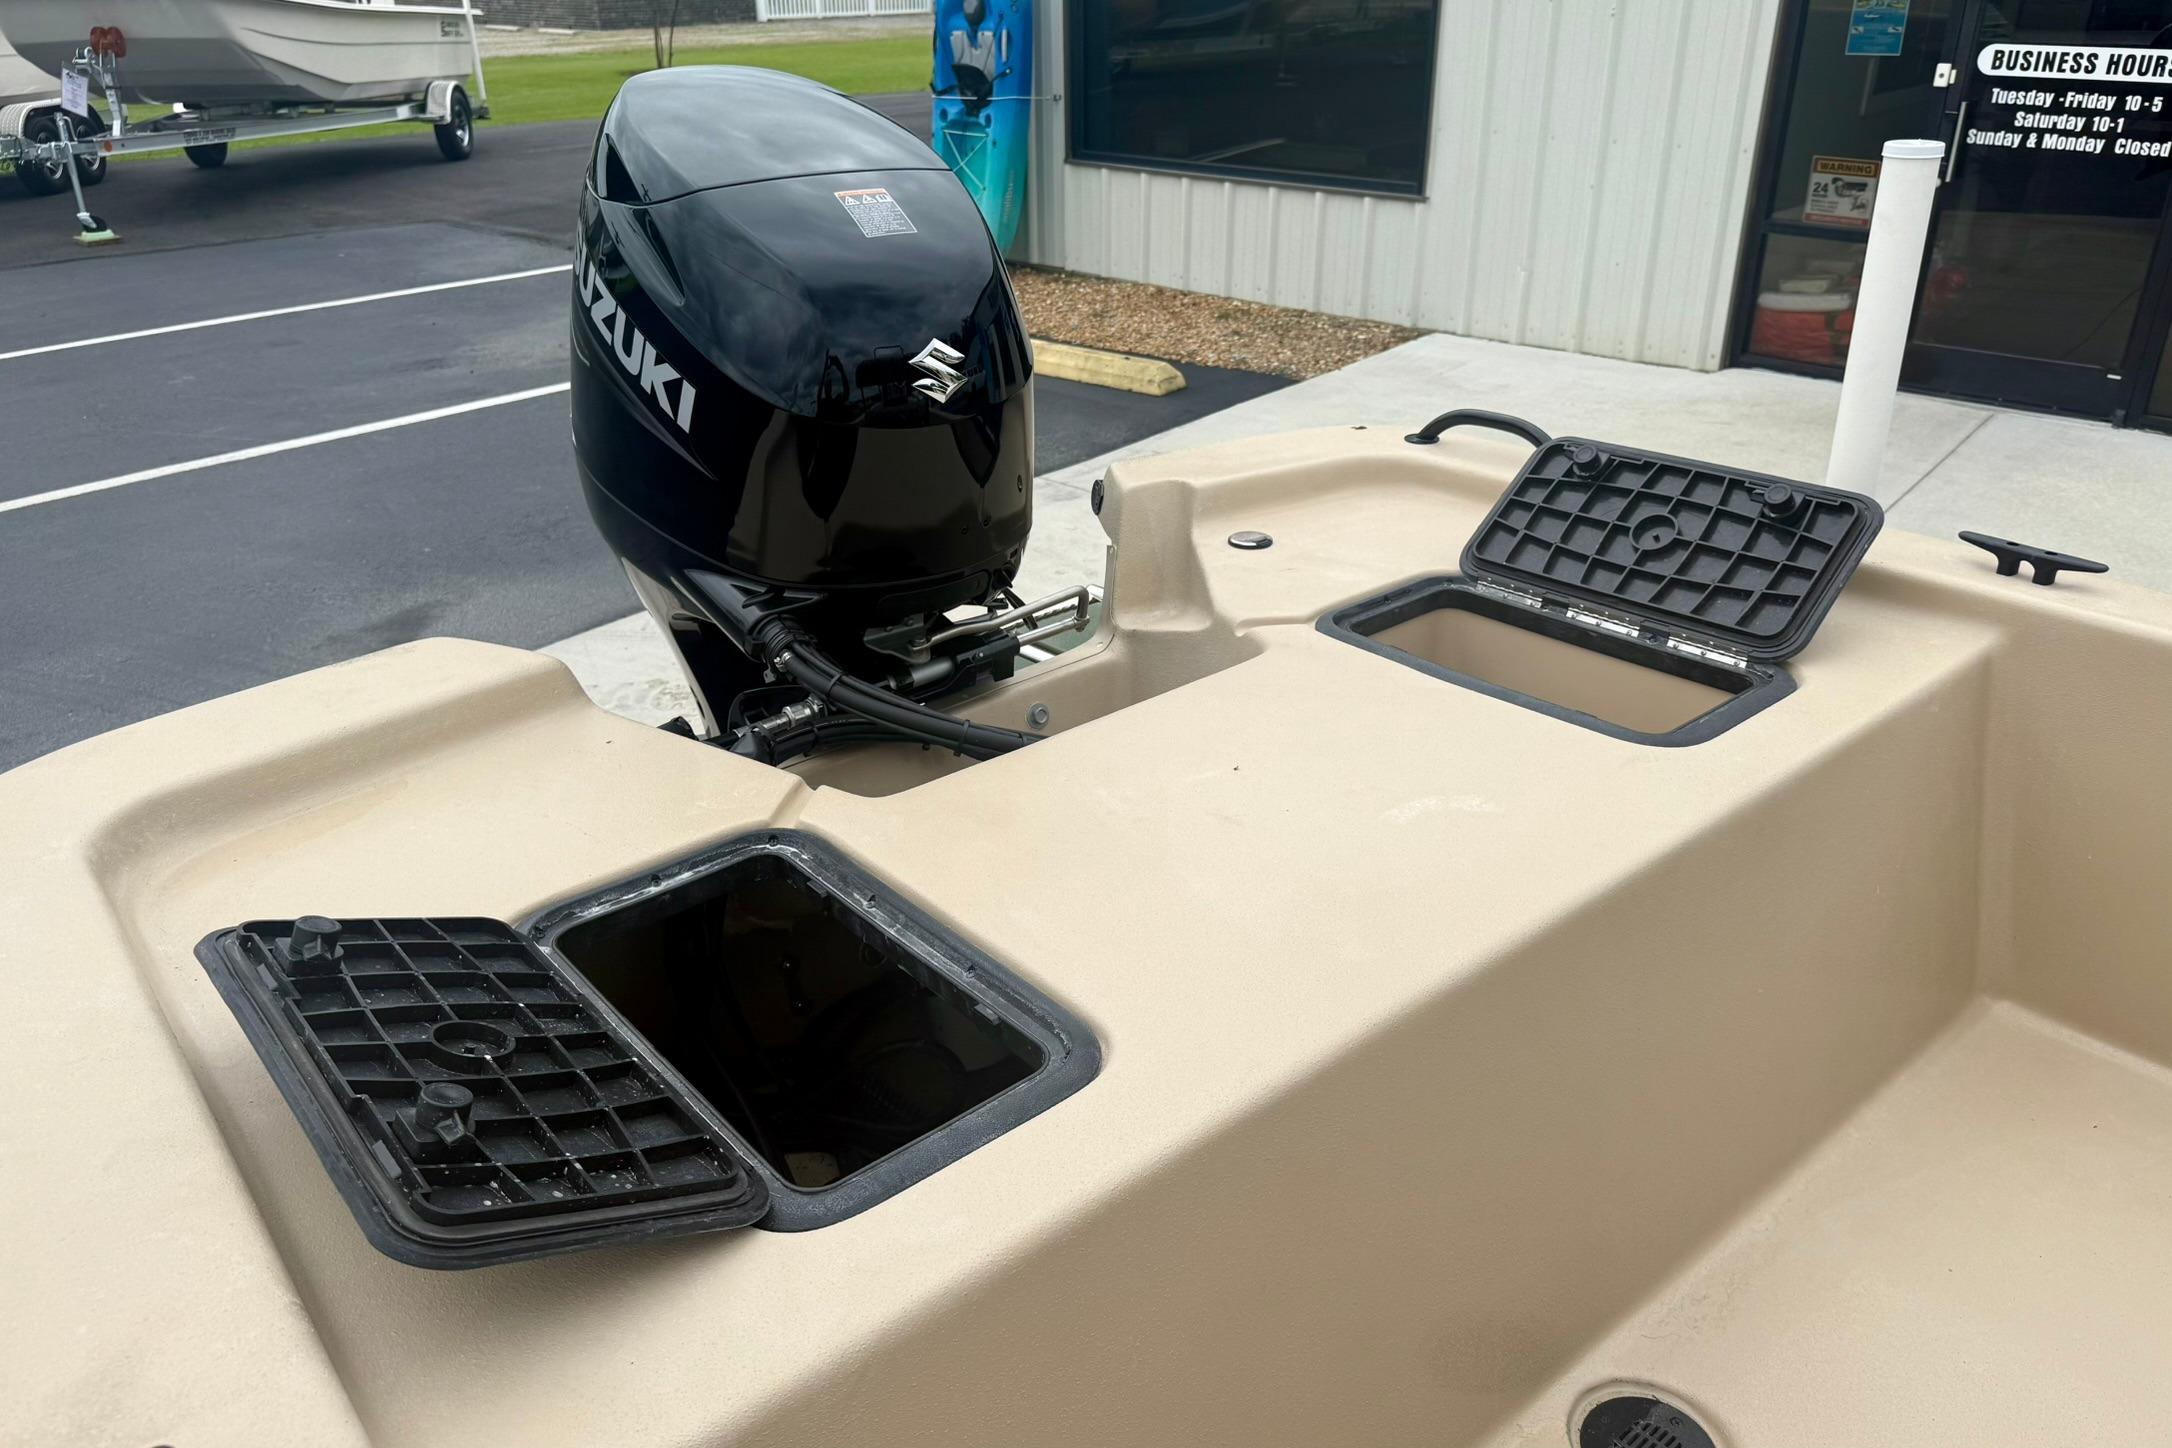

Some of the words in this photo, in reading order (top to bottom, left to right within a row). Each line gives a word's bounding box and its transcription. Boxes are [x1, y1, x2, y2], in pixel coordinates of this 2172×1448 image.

[1991, 49, 2099, 74] BUSINESS
[1991, 88, 2055, 108] Tuesday
[2014, 111, 2086, 132] Saturday
[2092, 116, 2125, 133] 10-1
[1966, 128, 2023, 148] Sunday
[2026, 132, 2038, 149] &
[2042, 133, 2106, 154] Monday
[2114, 138, 2172, 158] Closed
[1819, 162, 1873, 174] WARNING
[1813, 181, 1829, 194] 24
